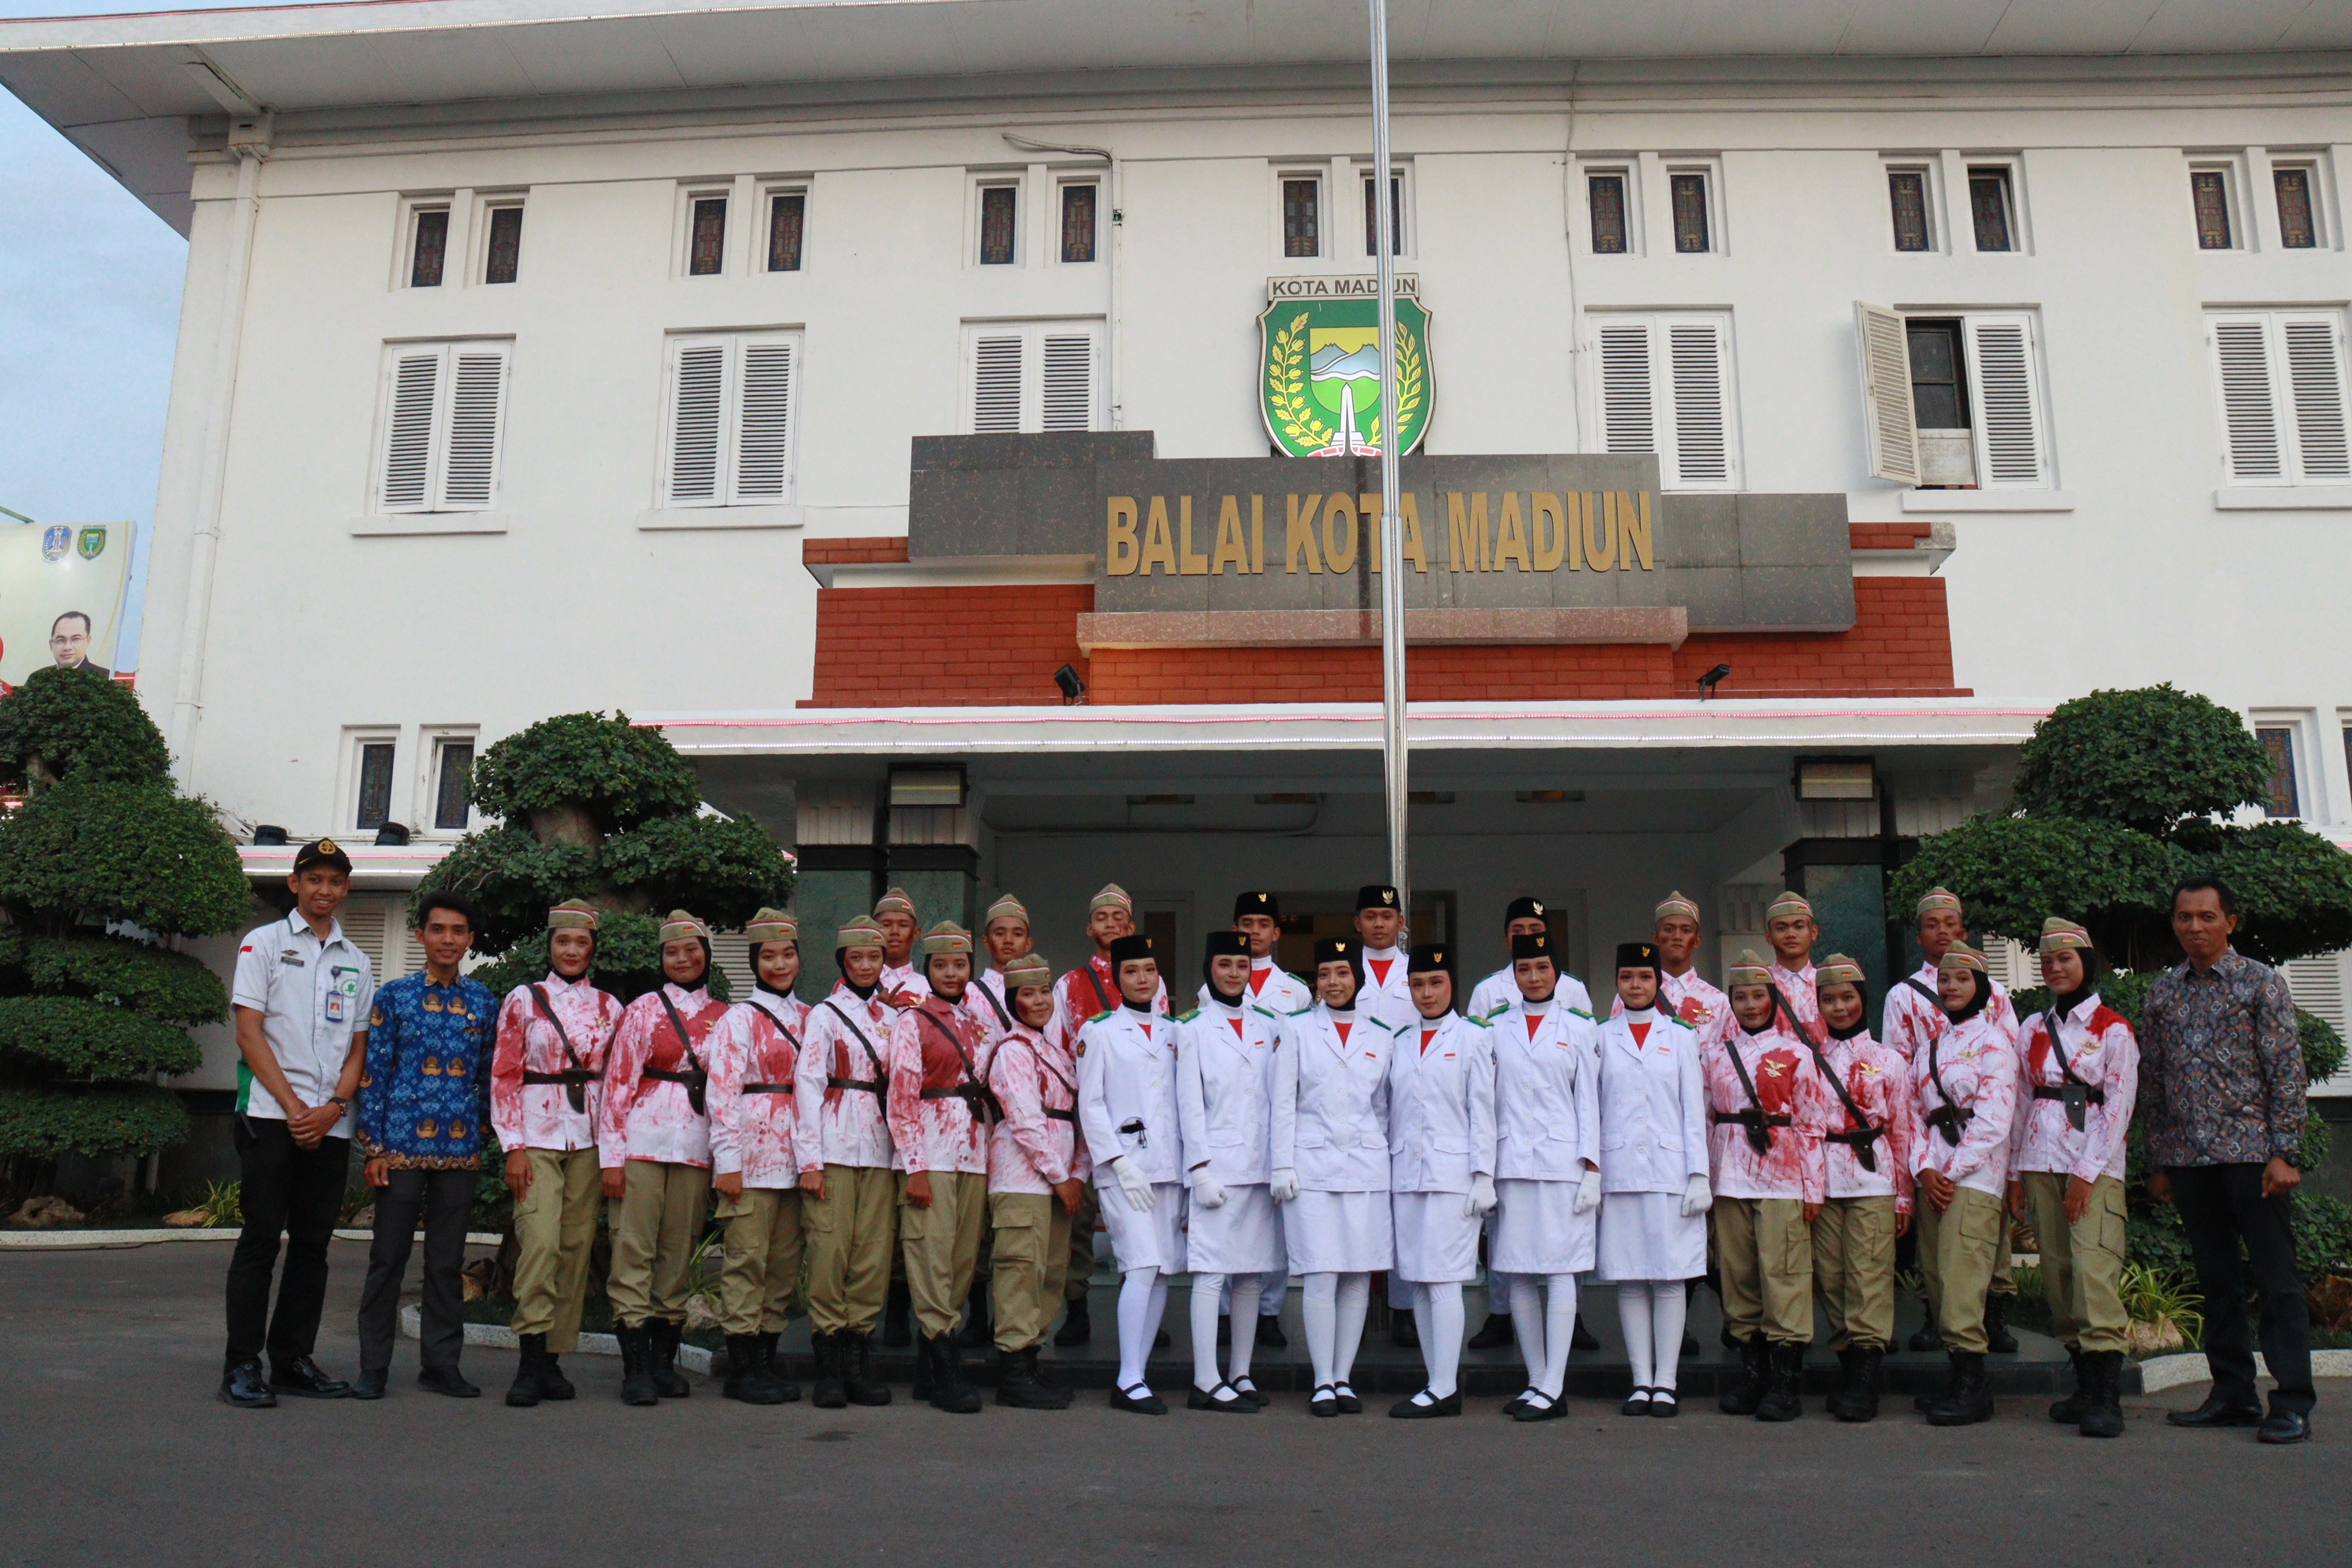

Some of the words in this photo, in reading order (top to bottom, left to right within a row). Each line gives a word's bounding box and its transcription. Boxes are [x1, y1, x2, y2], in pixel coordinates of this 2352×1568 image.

[1272, 280, 1329, 296] KOTA
[1334, 278, 1416, 294] MADUN
[1107, 494, 1265, 576] BALAI
[1286, 491, 1428, 575] KOTA
[1447, 490, 1654, 572] MADIUN
